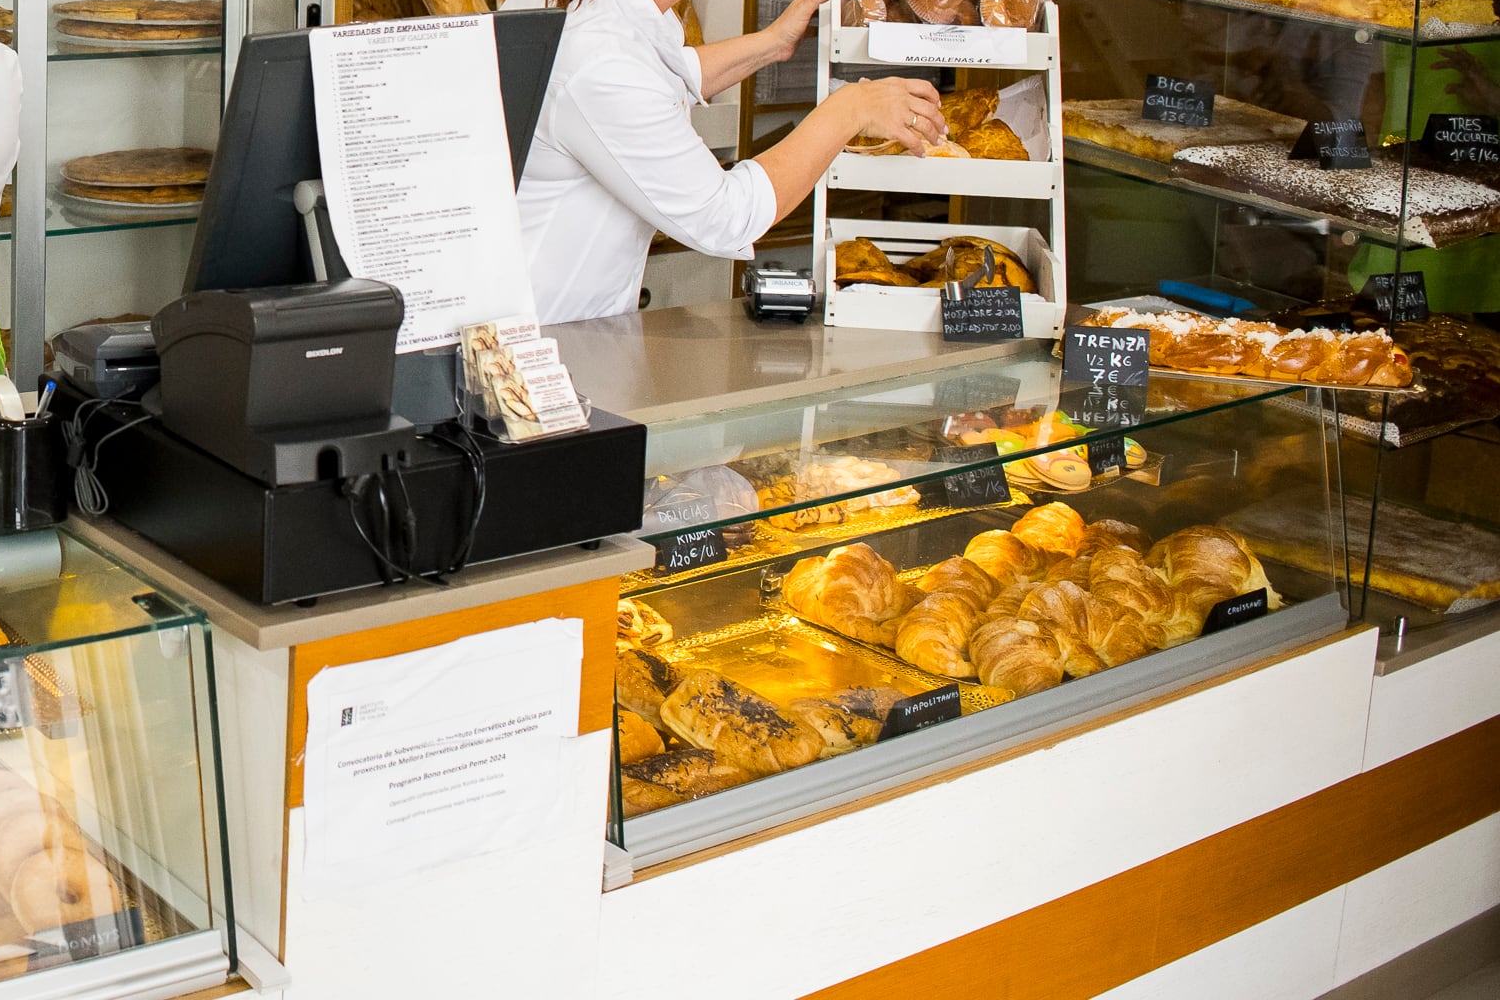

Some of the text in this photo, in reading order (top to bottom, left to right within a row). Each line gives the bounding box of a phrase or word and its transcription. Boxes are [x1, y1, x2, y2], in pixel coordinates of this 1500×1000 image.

[332, 28, 381, 38] VARIEDADES
[396, 23, 441, 33] EMPANADAS
[443, 20, 479, 29] GALLEGAS
[905, 56, 974, 64] MAGDALENAS
[1146, 94, 1205, 113] GALLEGA
[1449, 117, 1482, 131] TRES
[1435, 131, 1499, 144] CHOCOLATES
[1001, 324, 1021, 332] 2,00
[1074, 333, 1147, 352] TRENZA
[306, 346, 344, 360] BIXOLON
[1110, 352, 1132, 368] KG
[657, 504, 709, 522] DELICIAS
[905, 691, 959, 717] NAPOLITANAS
[337, 753, 382, 768] Convocatoria
[474, 721, 506, 735] Enerxético
[517, 714, 537, 723] Galicia
[538, 709, 552, 719] para
[353, 764, 386, 776] proxectos
[399, 754, 423, 765] Mellora
[425, 744, 458, 758] Enerxética
[515, 724, 538, 734] servizos
[389, 776, 421, 789] Programa
[423, 770, 441, 780] Bono
[469, 759, 488, 768] Peme
[489, 753, 506, 763] 2024
